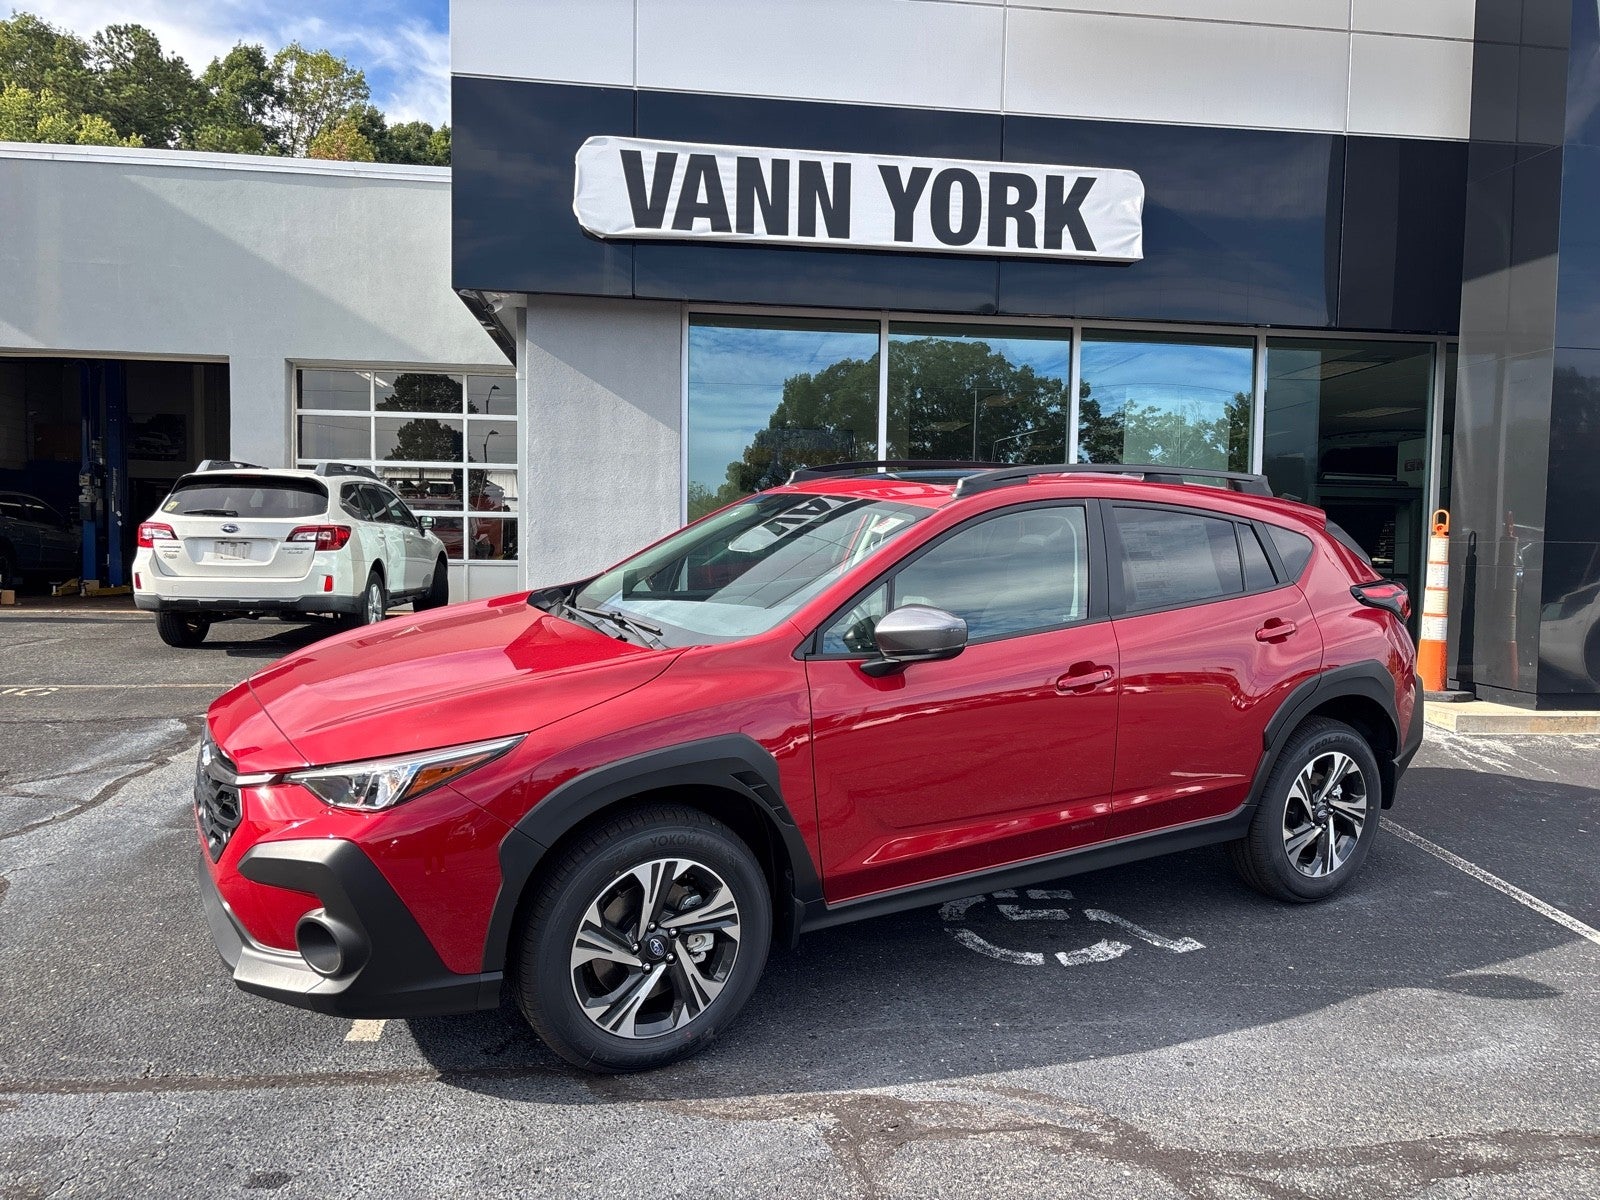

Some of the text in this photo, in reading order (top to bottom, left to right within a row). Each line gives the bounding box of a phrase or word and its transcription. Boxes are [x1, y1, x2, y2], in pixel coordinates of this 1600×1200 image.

[619, 149, 1098, 252] VANN YORK
[650, 833, 721, 852] YOKOHA
